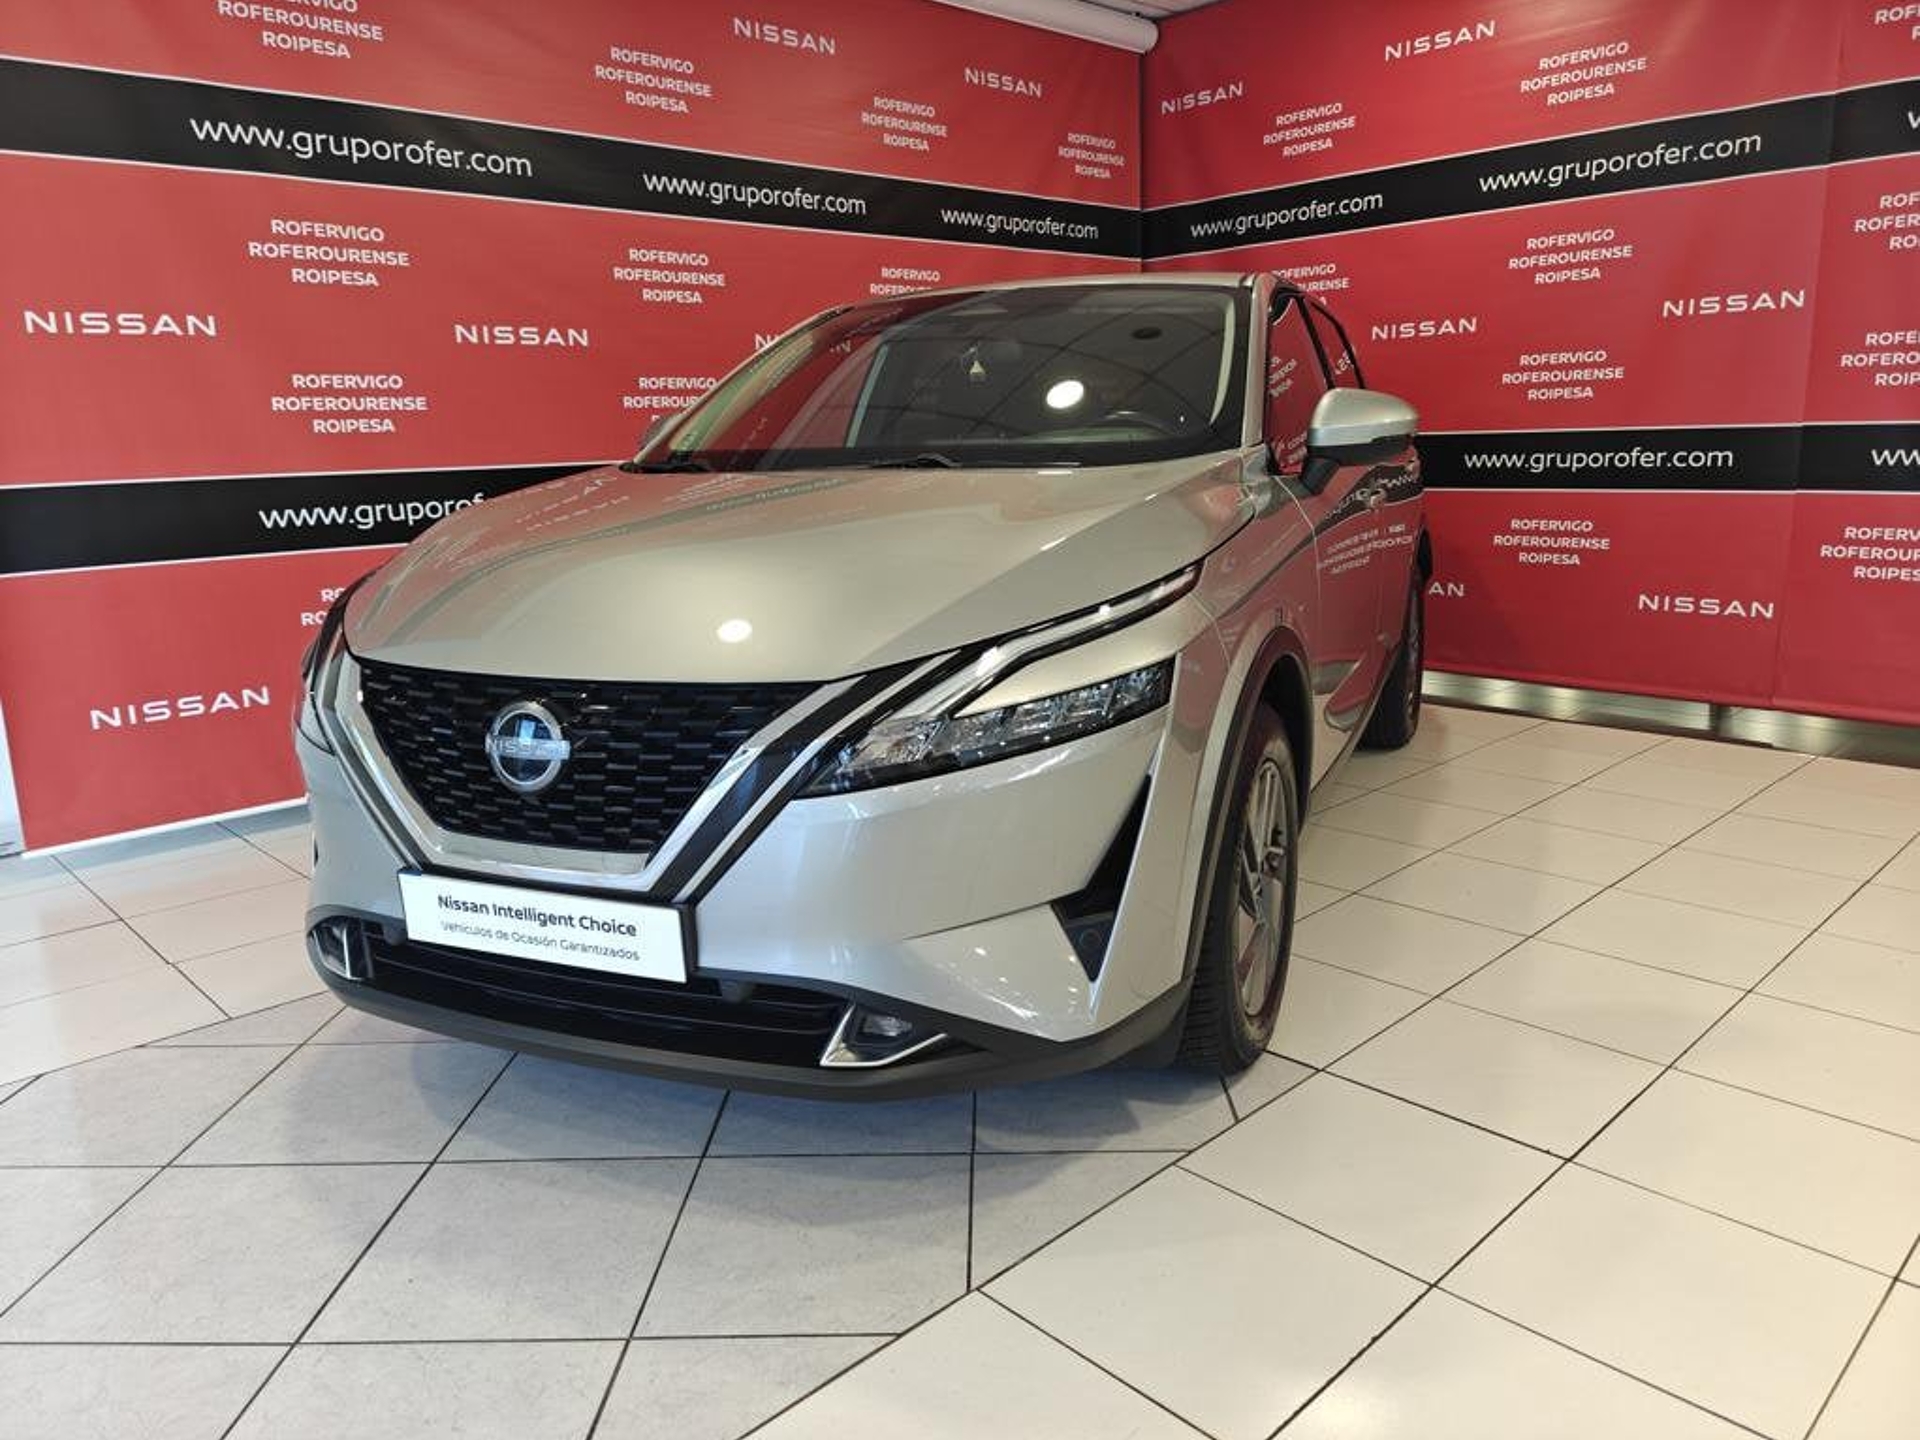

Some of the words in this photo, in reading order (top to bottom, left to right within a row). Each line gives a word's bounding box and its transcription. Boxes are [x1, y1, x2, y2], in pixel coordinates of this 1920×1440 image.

[217, 0, 384, 41] ROFEROURENSE
[262, 31, 351, 58] ROIPESA
[733, 17, 836, 55] NISSAN
[1384, 20, 1496, 62] NISSAN
[610, 47, 694, 73] ROFERVIGO
[1539, 41, 1629, 70] ROFERVIGO
[594, 66, 711, 96] ROFEROURENSE
[964, 67, 1042, 97] NISSAN
[1521, 58, 1648, 92] ROFEROURENSE
[625, 90, 689, 113] ROIPESA
[1161, 82, 1243, 115] NISSAN
[1547, 83, 1614, 106] ROIPESA
[873, 97, 935, 118] ROFERVIGO
[1276, 103, 1342, 126] ROFERVIGO
[861, 113, 948, 137] ROFEROURENSE
[1263, 116, 1356, 145] ROFEROURENSE
[190, 118, 533, 177] www.gruporofer.com
[883, 133, 930, 151] ROIPESA
[1067, 132, 1116, 149] ROFERVIGO
[1282, 138, 1333, 157] ROIPESA
[1058, 146, 1125, 166] ROFEROURENSE
[1479, 134, 1762, 192] www.gruporofer.com
[1074, 164, 1111, 179] ROIPESA
[643, 173, 867, 216] www.gruporofer.com
[941, 209, 1099, 240] www.gruporofer.com
[1190, 194, 1383, 237] www.gruporofer.com
[270, 219, 385, 241] ROFERVIGO
[1527, 229, 1615, 249] ROFERVIGO
[248, 243, 410, 266] ROFEROURENSE
[628, 249, 709, 266] ROFERVIGO
[1509, 245, 1633, 269] ROFEROURENSE
[291, 268, 379, 286] ROIPESA
[613, 268, 725, 286] ROFEROURENSE
[1535, 268, 1601, 284] ROIPESA
[642, 289, 702, 304] ROIPESA
[1662, 290, 1805, 317] NISSAN
[24, 311, 218, 336] NISSAN
[1372, 317, 1478, 340] NISSAN
[455, 325, 588, 347] NISSAN
[1519, 350, 1607, 366] ROFERVIGO
[292, 374, 403, 389] ROFERVIGO
[638, 377, 718, 389] ROFERVIGO
[1502, 367, 1624, 384] ROFEROURENSE
[271, 397, 428, 411] ROFEROURENSE
[1528, 387, 1593, 400] ROIPESA
[312, 420, 396, 433] ROIPESA
[1464, 448, 1733, 473] www.gruporofer.com
[1511, 519, 1593, 532] ROFERVIGO
[1493, 535, 1610, 550] ROFEROURENSE
[1518, 552, 1580, 565] ROIPESA
[1638, 595, 1774, 619] NISSAN
[90, 686, 270, 730] NISSAN
[437, 894, 490, 915] Nissan
[493, 903, 575, 927] Intelligent
[578, 916, 637, 937] Choice
[496, 929, 510, 941] de
[560, 938, 641, 961] Garantizados
